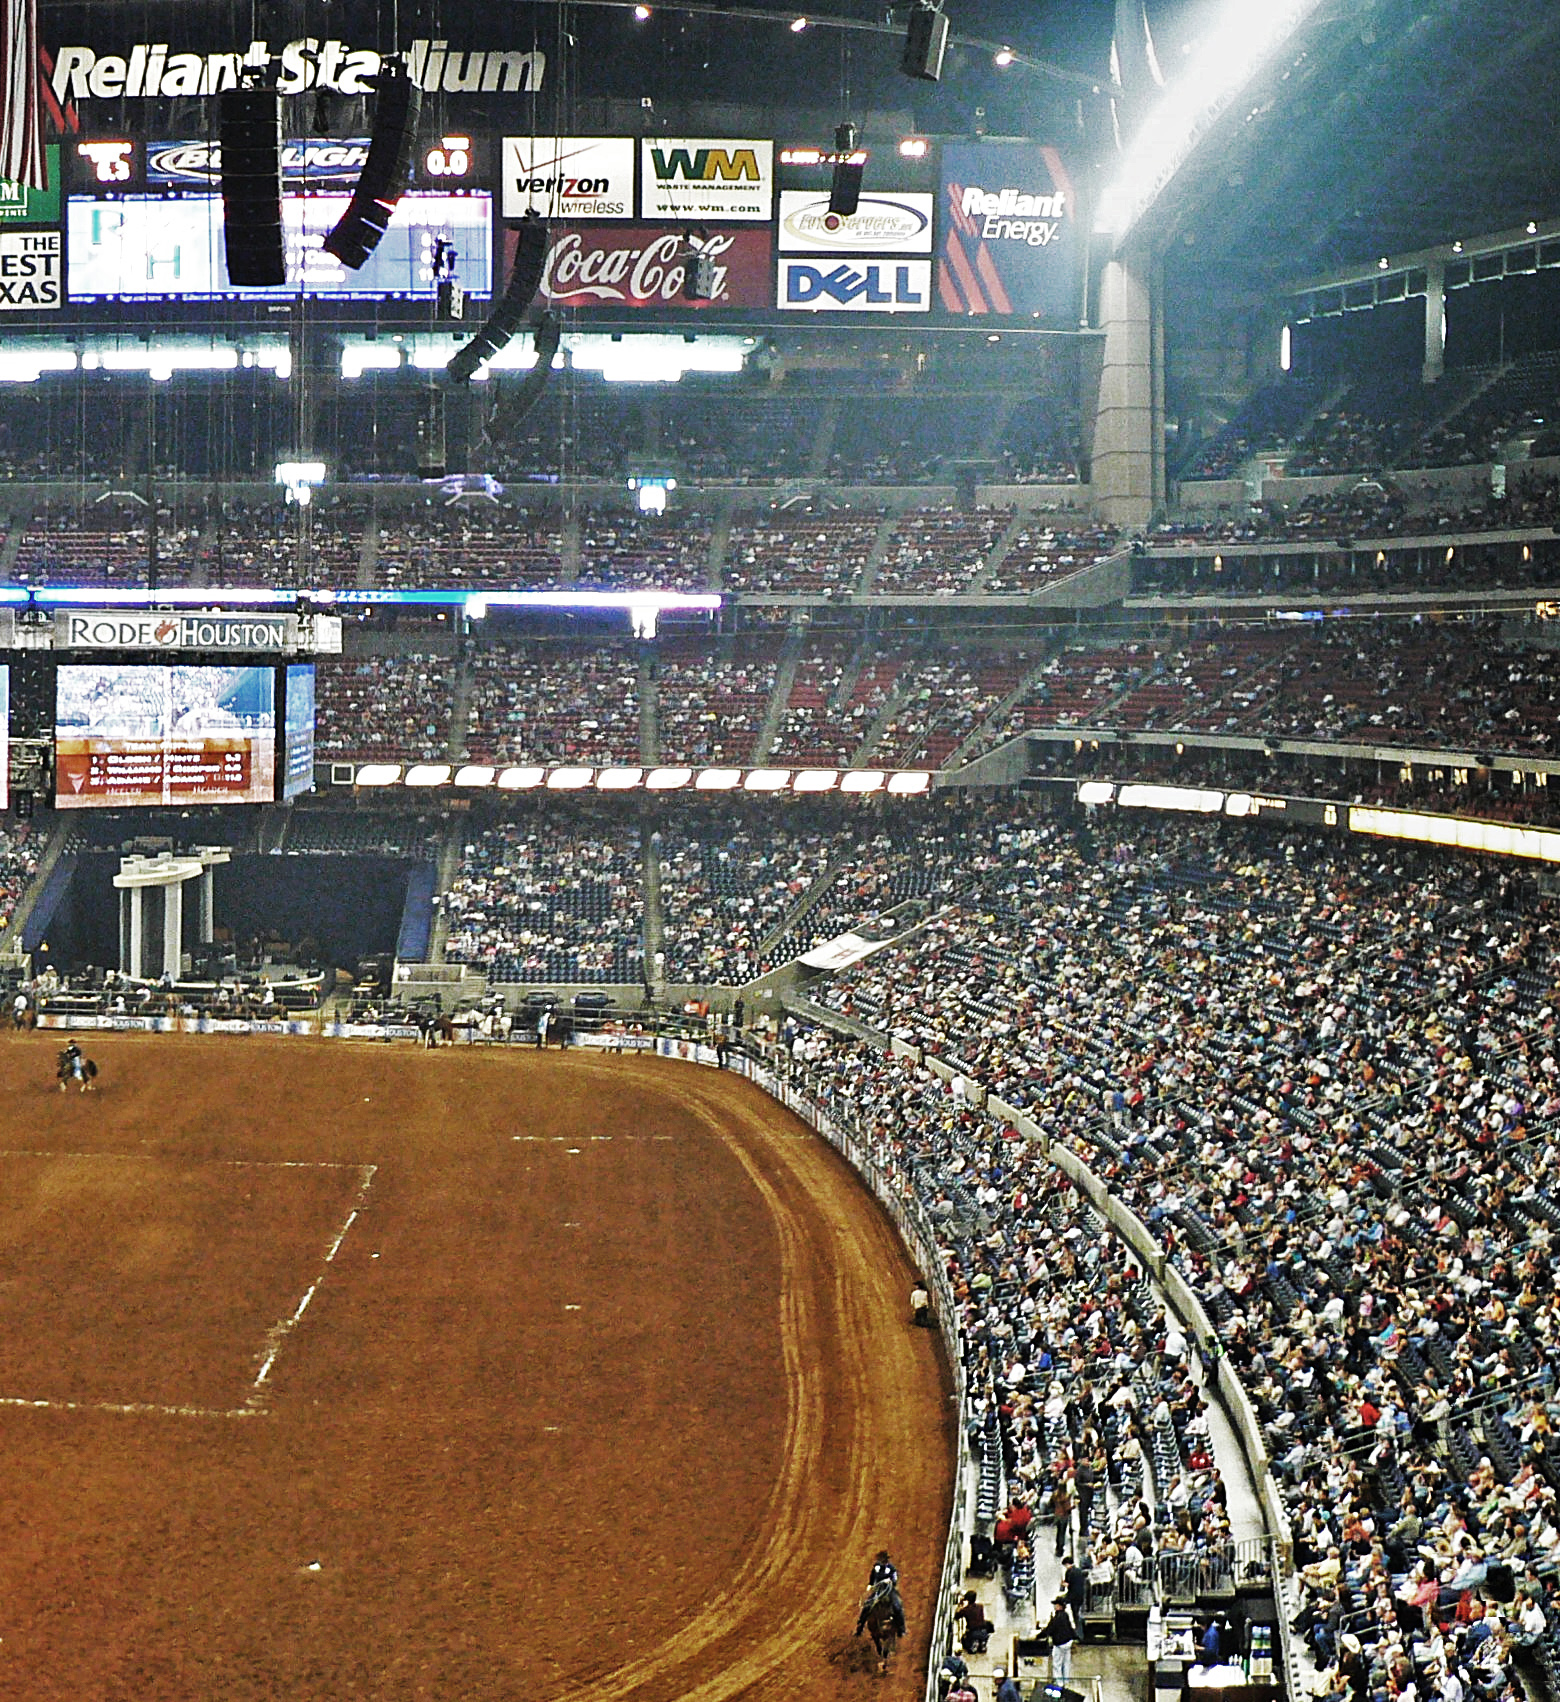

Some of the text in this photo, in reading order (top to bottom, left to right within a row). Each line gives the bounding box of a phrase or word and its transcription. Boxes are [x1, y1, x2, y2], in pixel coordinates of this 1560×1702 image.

[51, 41, 271, 105] Reliant
[281, 147, 370, 168] LIGH
[650, 149, 761, 181] WM
[516, 173, 610, 198] verizon
[561, 199, 625, 214] wireless
[656, 203, 762, 213] www.wm.com
[961, 186, 1066, 218] Reliant
[20, 237, 59, 251] THE
[981, 216, 1060, 246] Energy
[787, 264, 922, 305] DELL
[180, 618, 284, 647] HOUSTON
